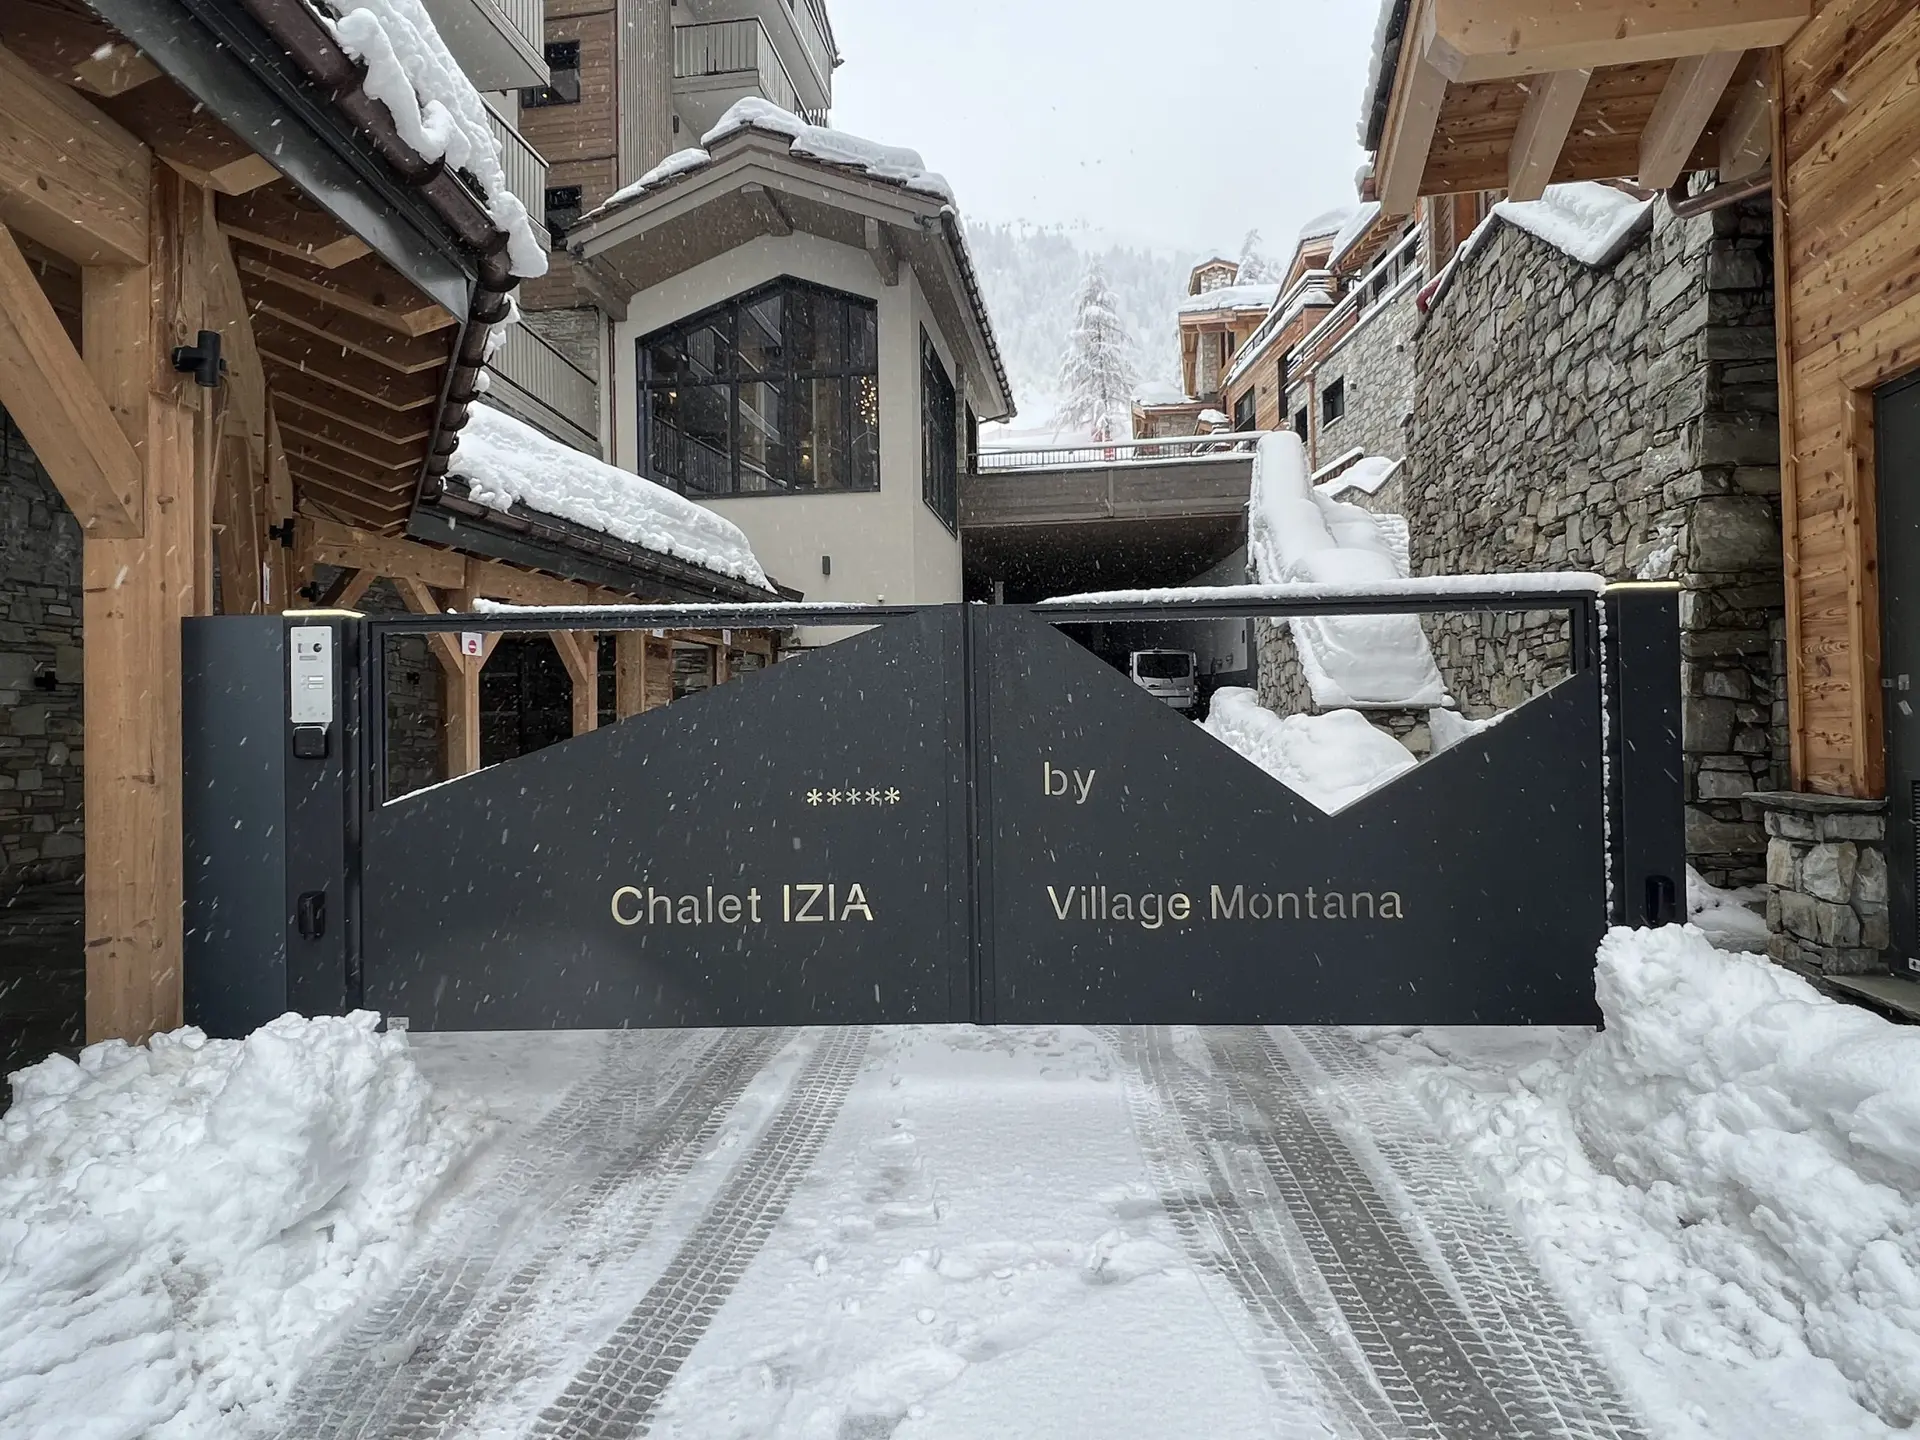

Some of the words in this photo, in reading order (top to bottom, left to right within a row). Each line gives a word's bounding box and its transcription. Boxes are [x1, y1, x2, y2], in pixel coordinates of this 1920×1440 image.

[1043, 761, 1096, 805] by
[610, 885, 763, 926] Chalet
[782, 883, 875, 923] IZIA
[1046, 885, 1191, 930] Village
[1210, 884, 1405, 920] Montana
